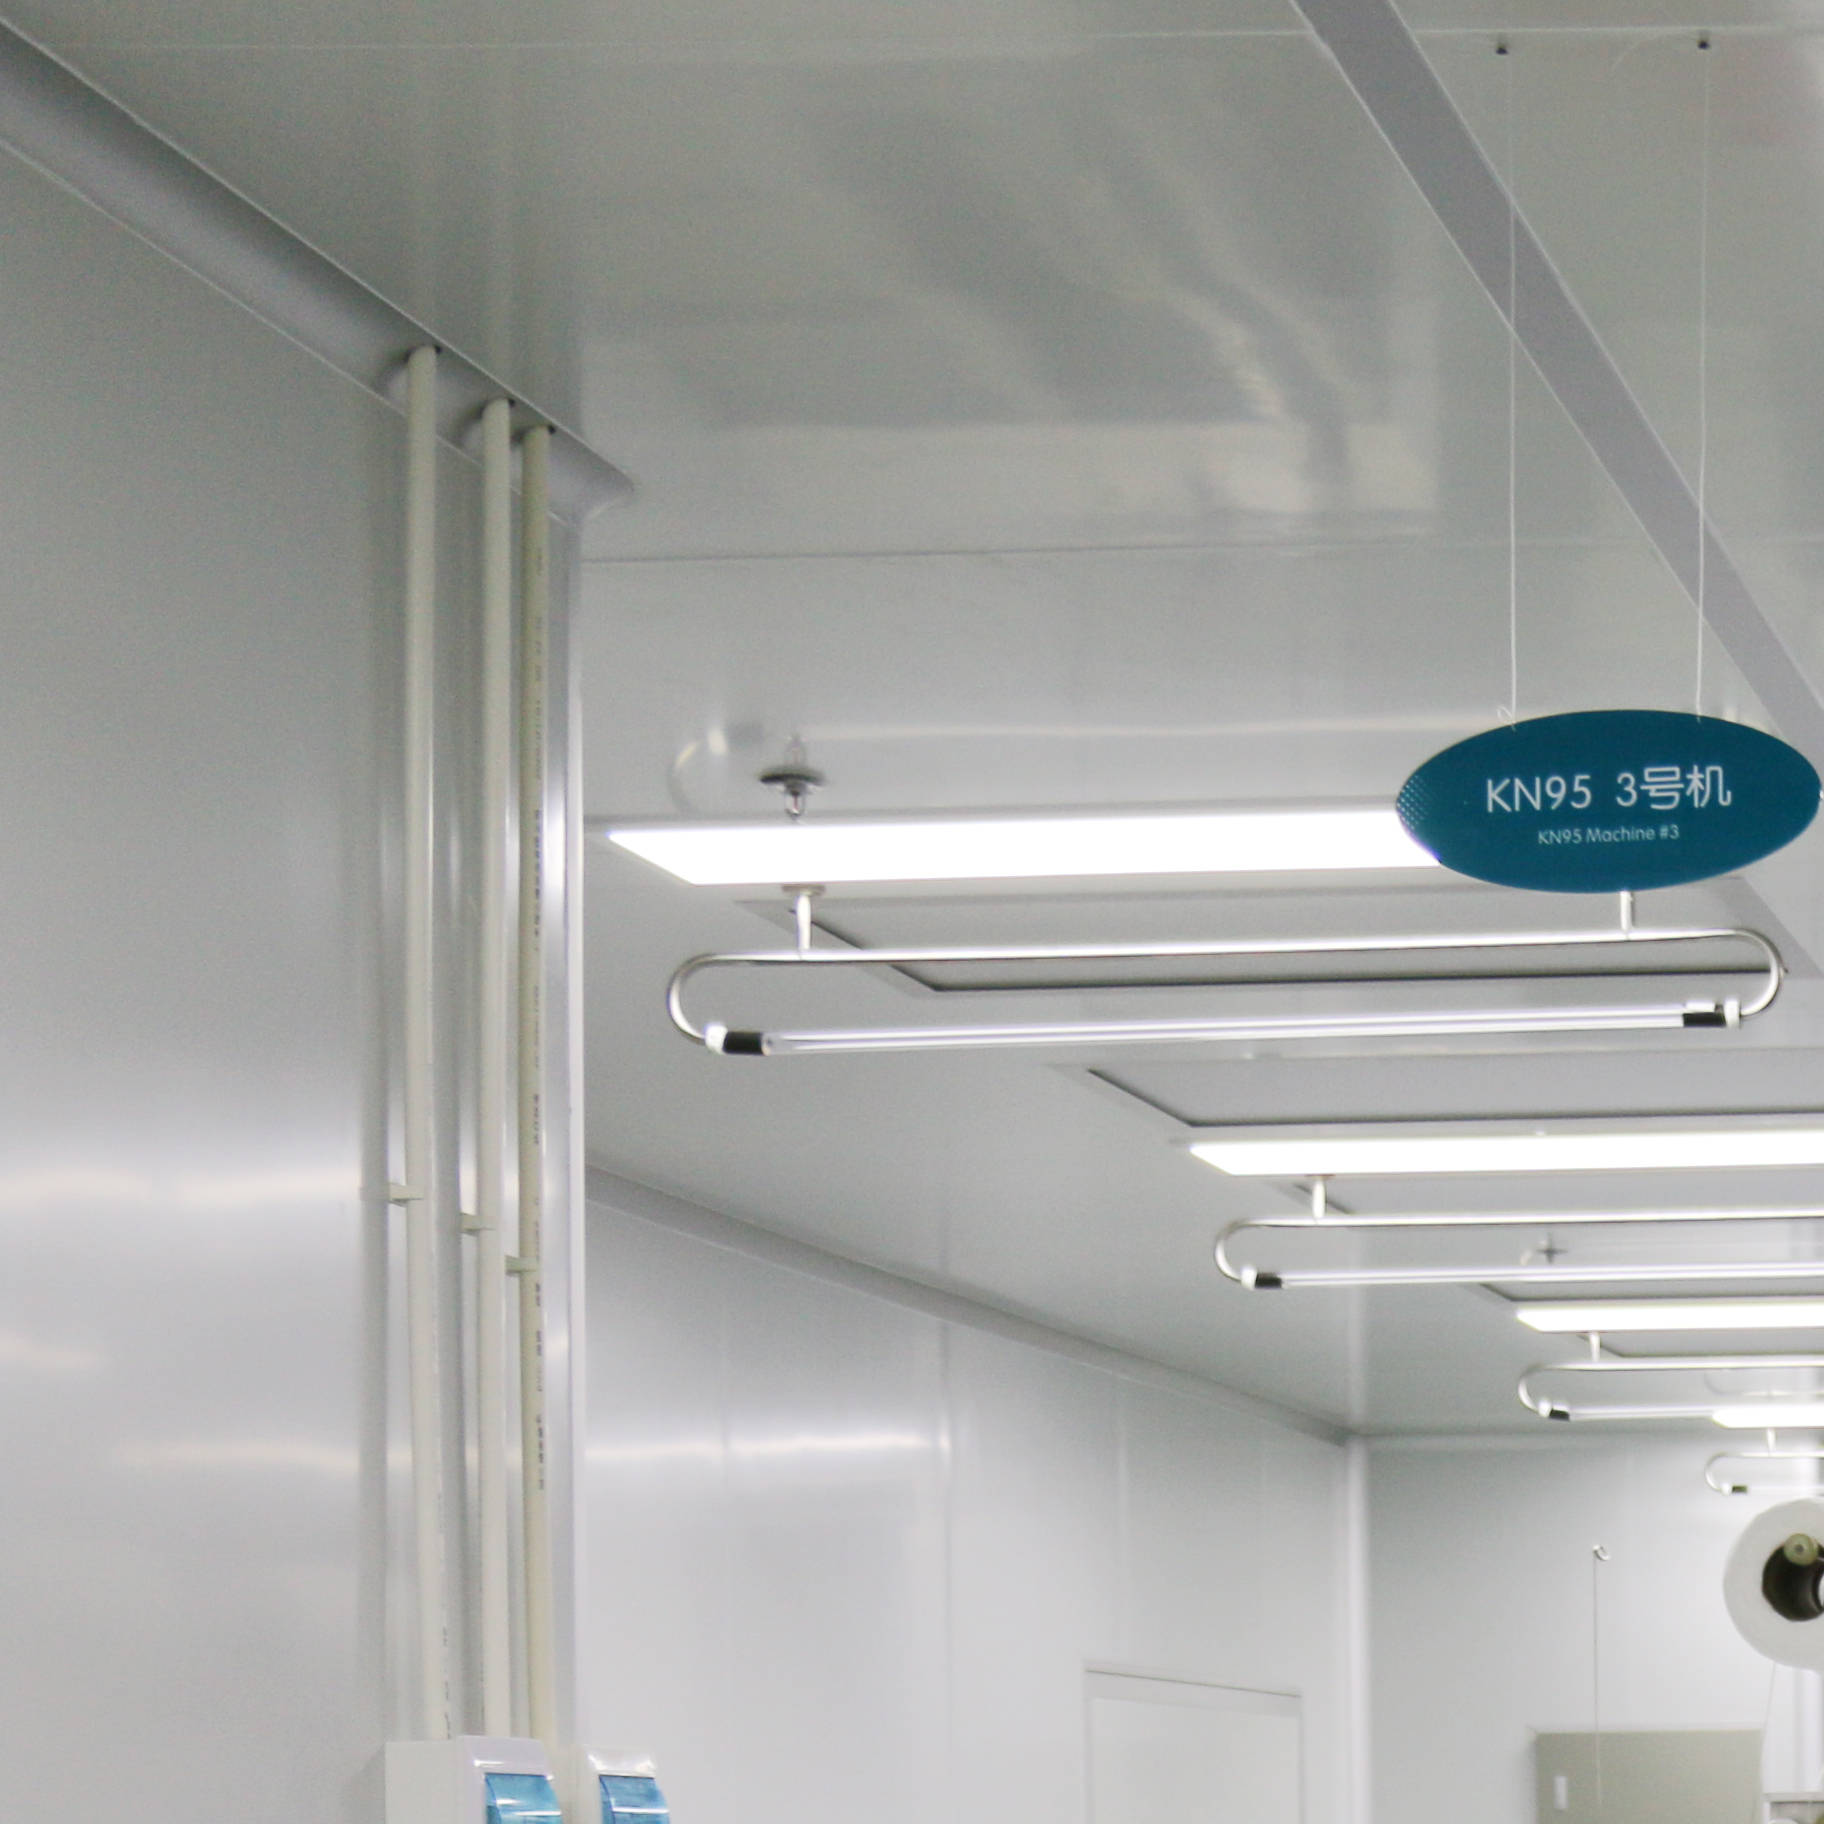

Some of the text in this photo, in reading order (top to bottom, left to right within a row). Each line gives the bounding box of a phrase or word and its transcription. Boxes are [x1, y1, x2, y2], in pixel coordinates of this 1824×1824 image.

[1486, 764, 1732, 813] KN95 3号机
[1537, 824, 1679, 845] KN95 Machine #3
